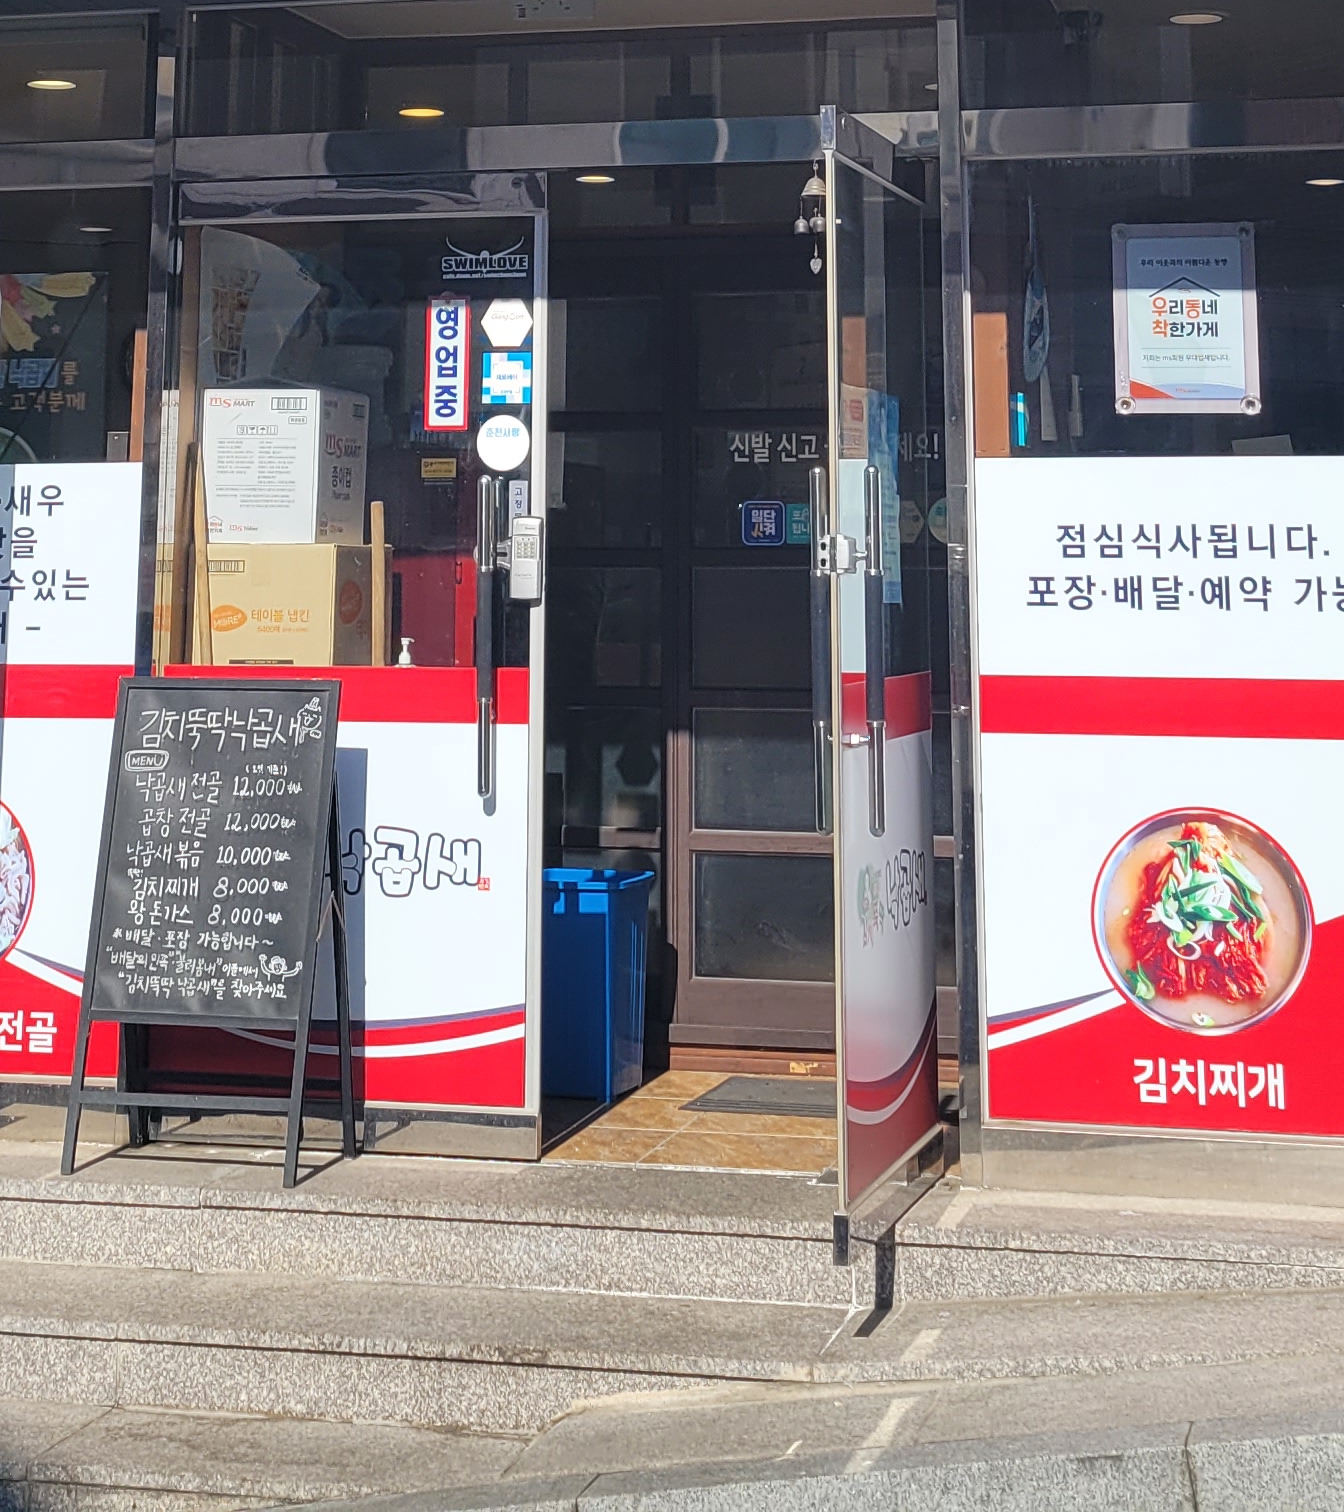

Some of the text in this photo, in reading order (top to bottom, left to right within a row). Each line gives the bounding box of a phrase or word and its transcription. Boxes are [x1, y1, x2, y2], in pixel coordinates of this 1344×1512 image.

[442, 255, 528, 271] SWIMLOVE
[1152, 297, 1218, 319] 우리동네
[1152, 319, 1218, 338] 착한가게
[434, 306, 459, 419] 영업중
[729, 433, 773, 463] 신발
[777, 433, 820, 463] 신고
[1056, 523, 1331, 559] 점심식사됩니다.
[251, 609, 310, 622] 테이블 냅킨
[131, 754, 163, 767] MENU
[136, 772, 186, 802] 낙곱새
[191, 771, 222, 806] 전골
[138, 807, 173, 837] 곱창
[179, 807, 210, 838] 전골
[127, 840, 173, 866] 낙곱새
[174, 839, 204, 869] 볶음
[132, 876, 199, 901] 김치찌개
[1132, 1057, 1286, 1110] 김치찌개
